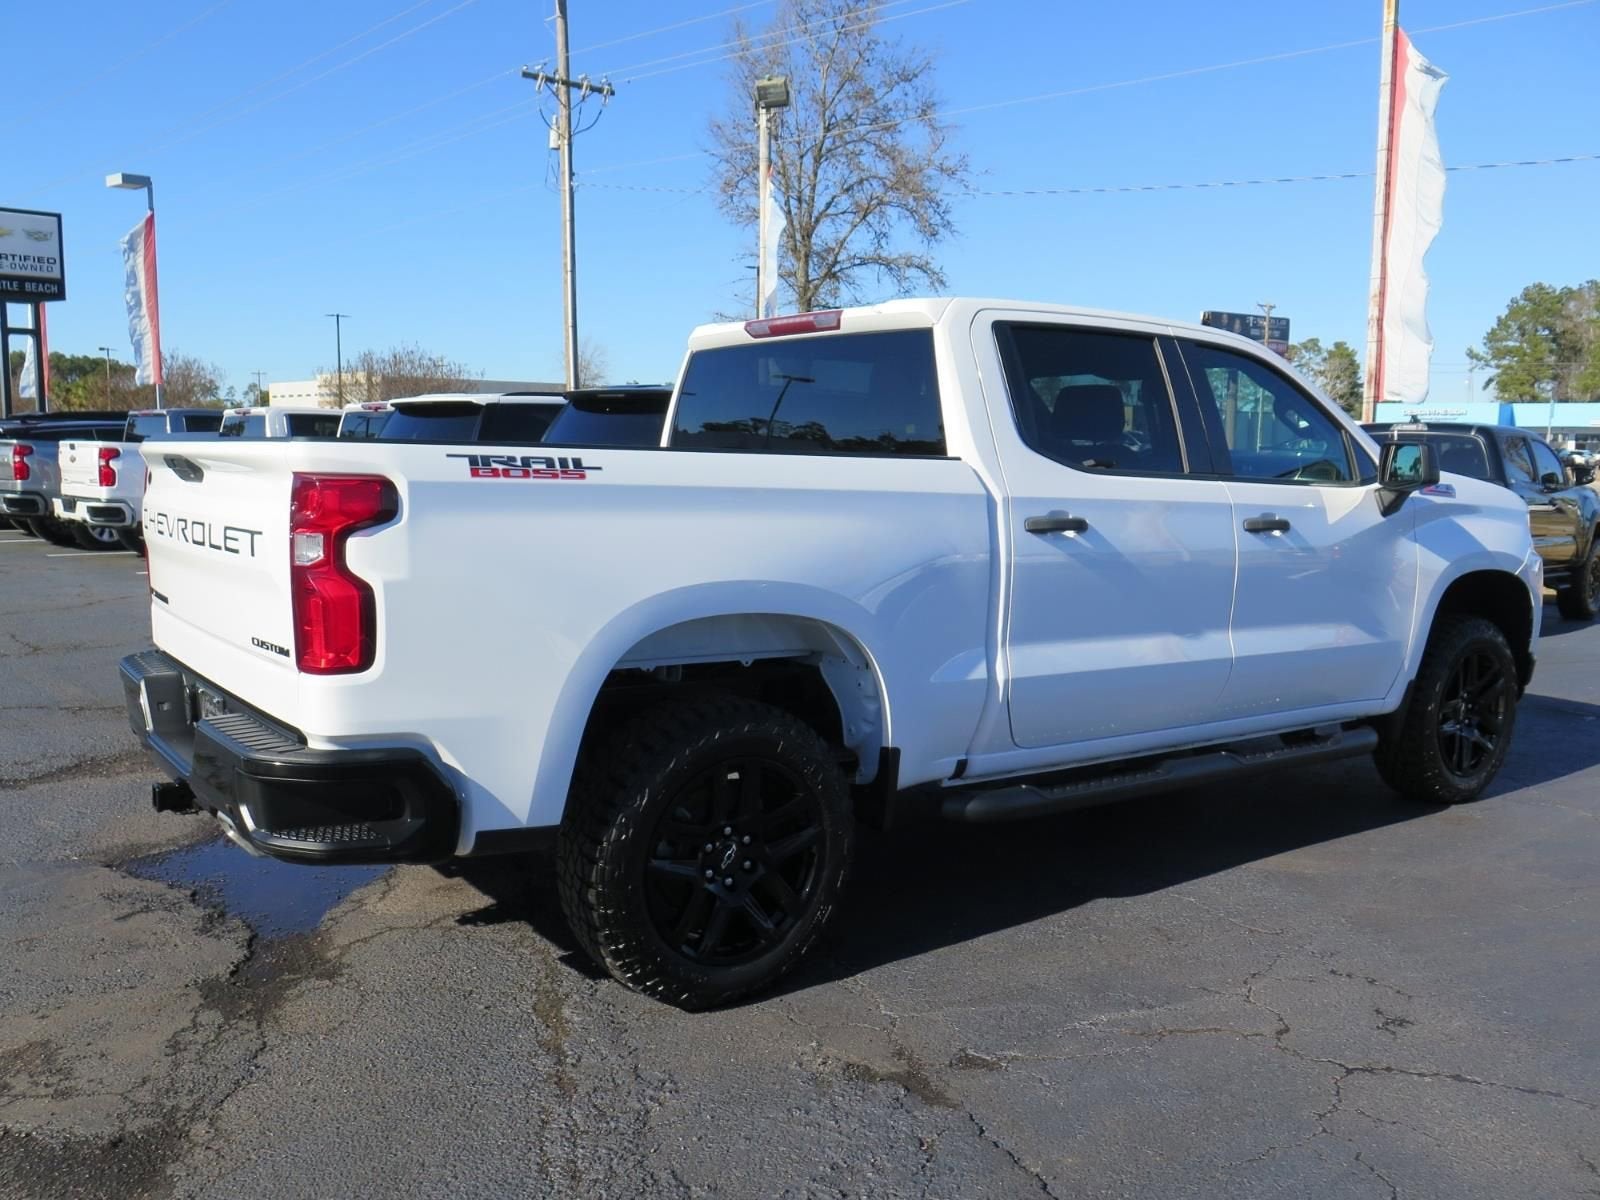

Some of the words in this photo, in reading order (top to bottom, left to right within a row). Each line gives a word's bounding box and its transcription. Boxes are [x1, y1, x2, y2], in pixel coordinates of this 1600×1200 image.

[0, 280, 19, 291] TLE
[25, 281, 58, 293] BEACH
[446, 453, 602, 470] TRAIL
[470, 467, 586, 480] BOSS
[251, 637, 290, 657] CUSTOM
